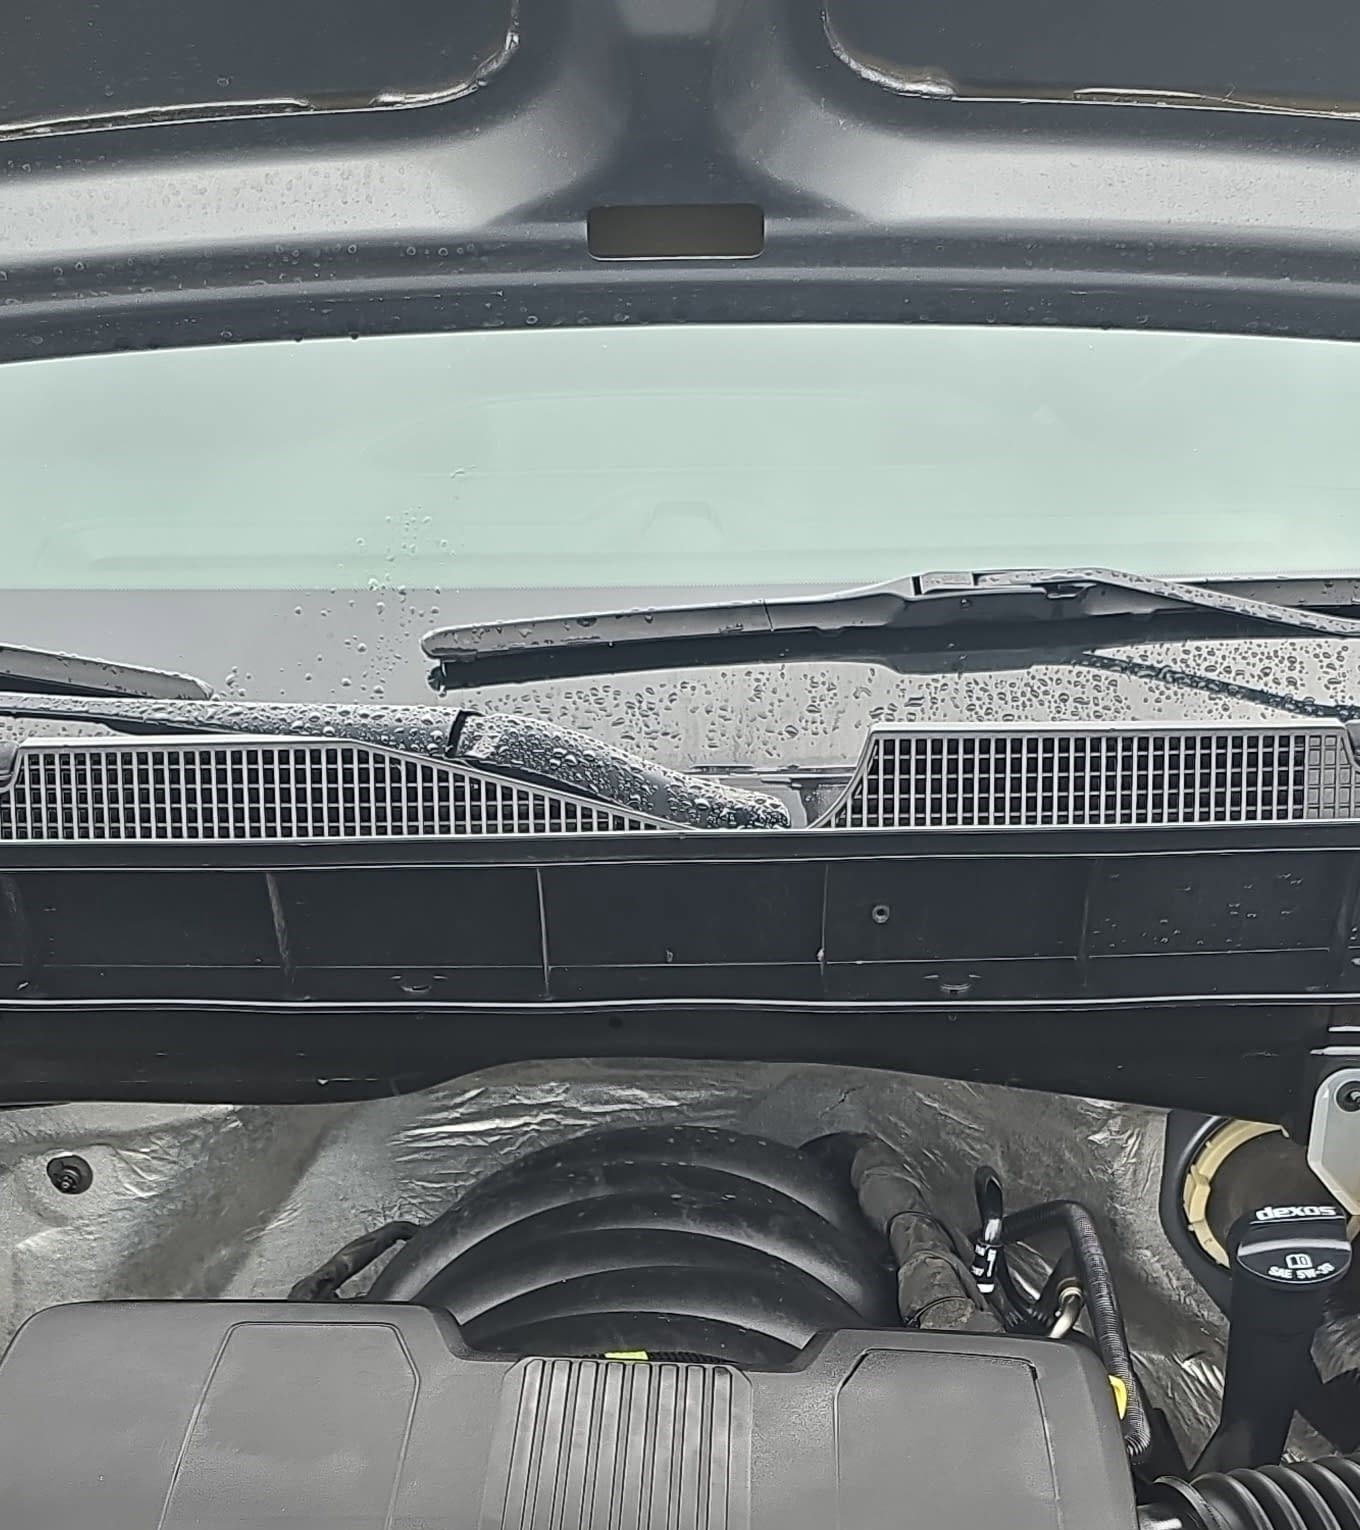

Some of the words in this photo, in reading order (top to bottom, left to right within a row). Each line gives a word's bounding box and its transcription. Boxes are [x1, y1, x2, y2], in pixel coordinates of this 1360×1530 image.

[1256, 1206, 1336, 1220] dexos
[1268, 1266, 1293, 1279] SAE
[1296, 1262, 1335, 1279] 5W-30
